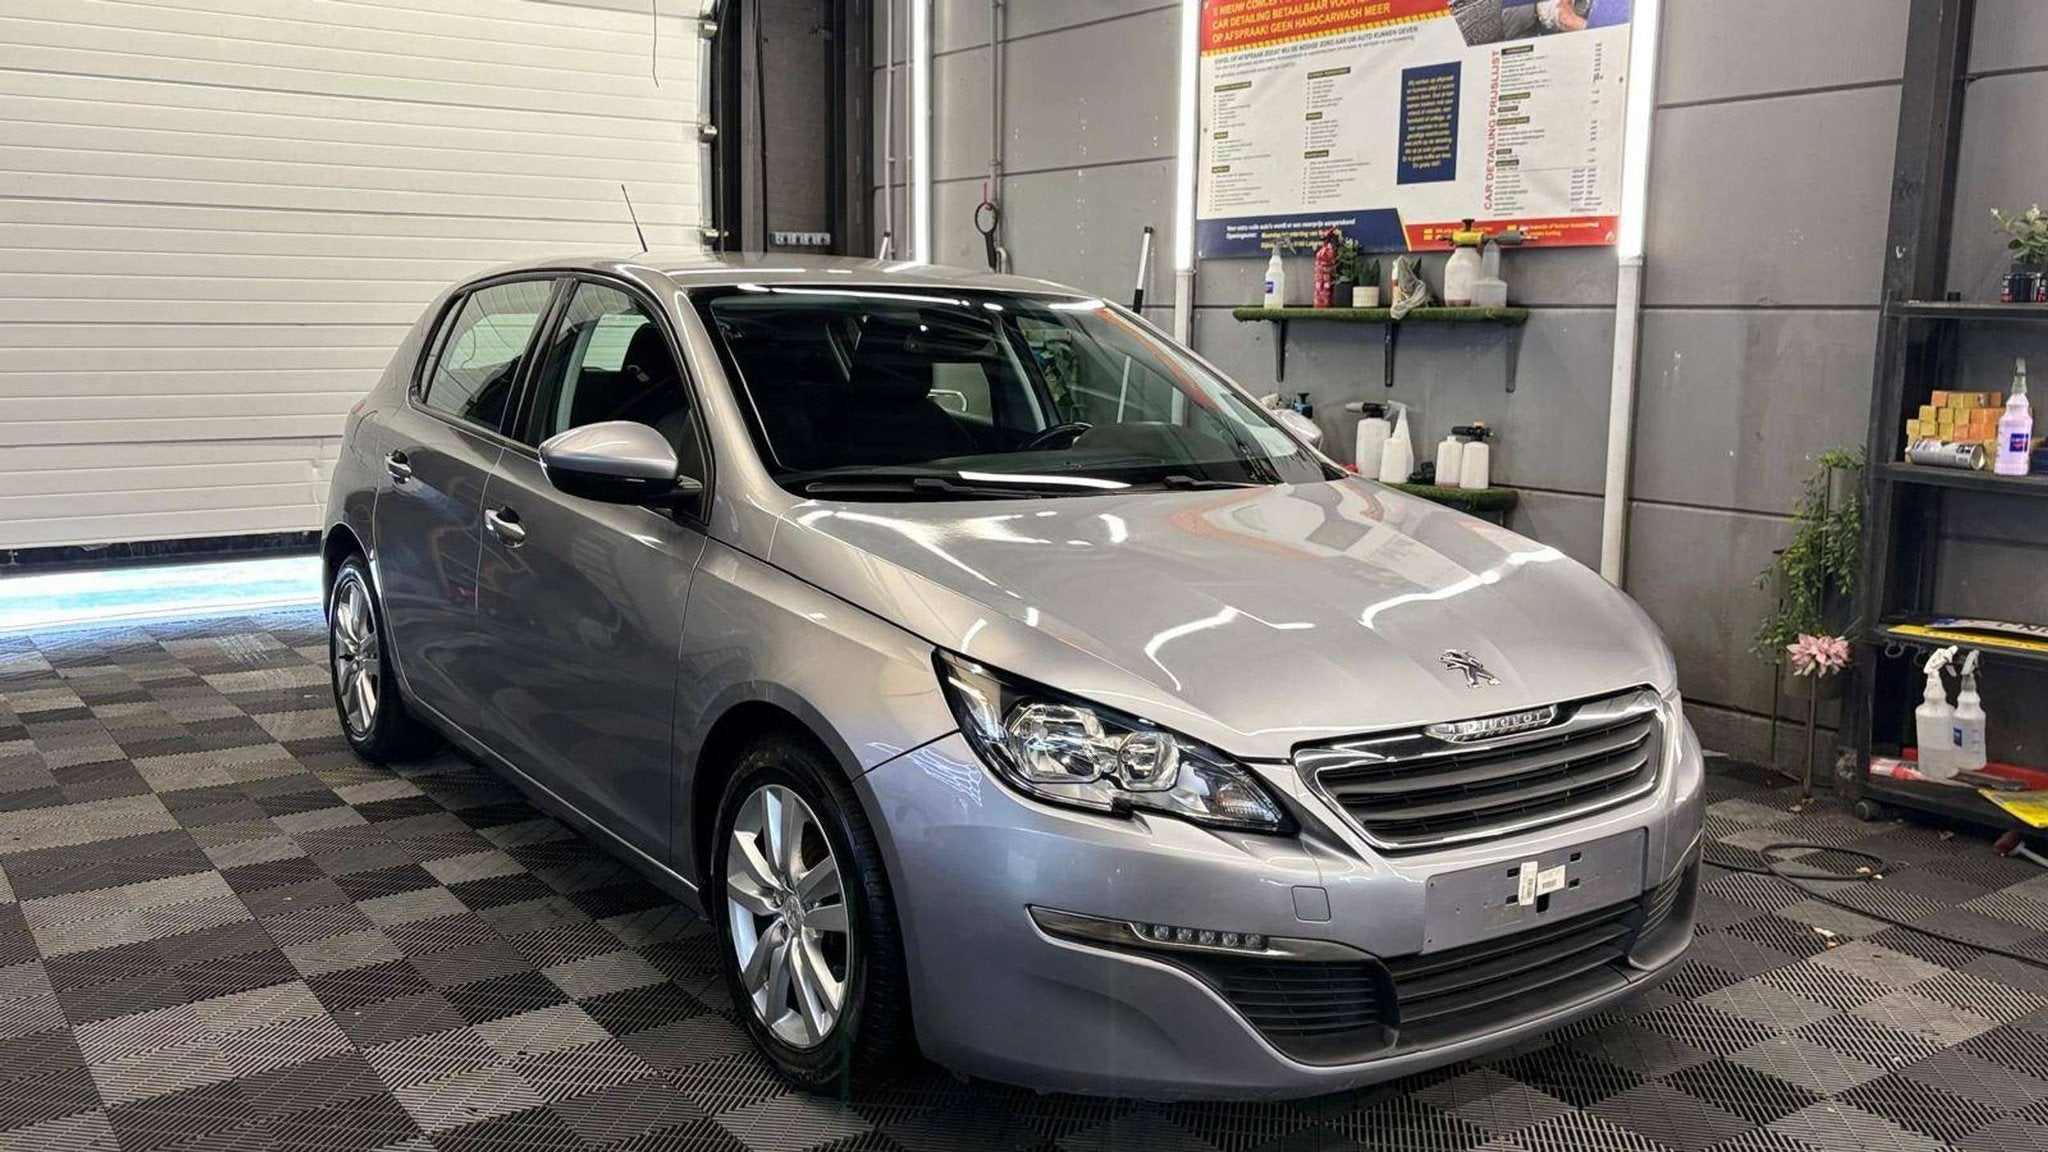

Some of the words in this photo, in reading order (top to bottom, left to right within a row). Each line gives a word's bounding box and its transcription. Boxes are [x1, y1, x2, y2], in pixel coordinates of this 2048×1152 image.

[1212, 33, 1223, 43] OP
[1224, 26, 1269, 40] AFSPRAAK!
[1271, 20, 1293, 33] GEEN
[1295, 7, 1363, 29] HANDCARWASH
[1364, 2, 1390, 16] MEER
[1213, 18, 1229, 29] CAR
[1230, 9, 1271, 27] DETAILING
[1272, 0, 1328, 19] BETAALBAAR
[1219, 2, 1246, 15] NIEUW
[1489, 50, 1500, 116] PRIJSLIJST
[1486, 119, 1496, 181] DETAILING
[1484, 184, 1493, 210] CAR
